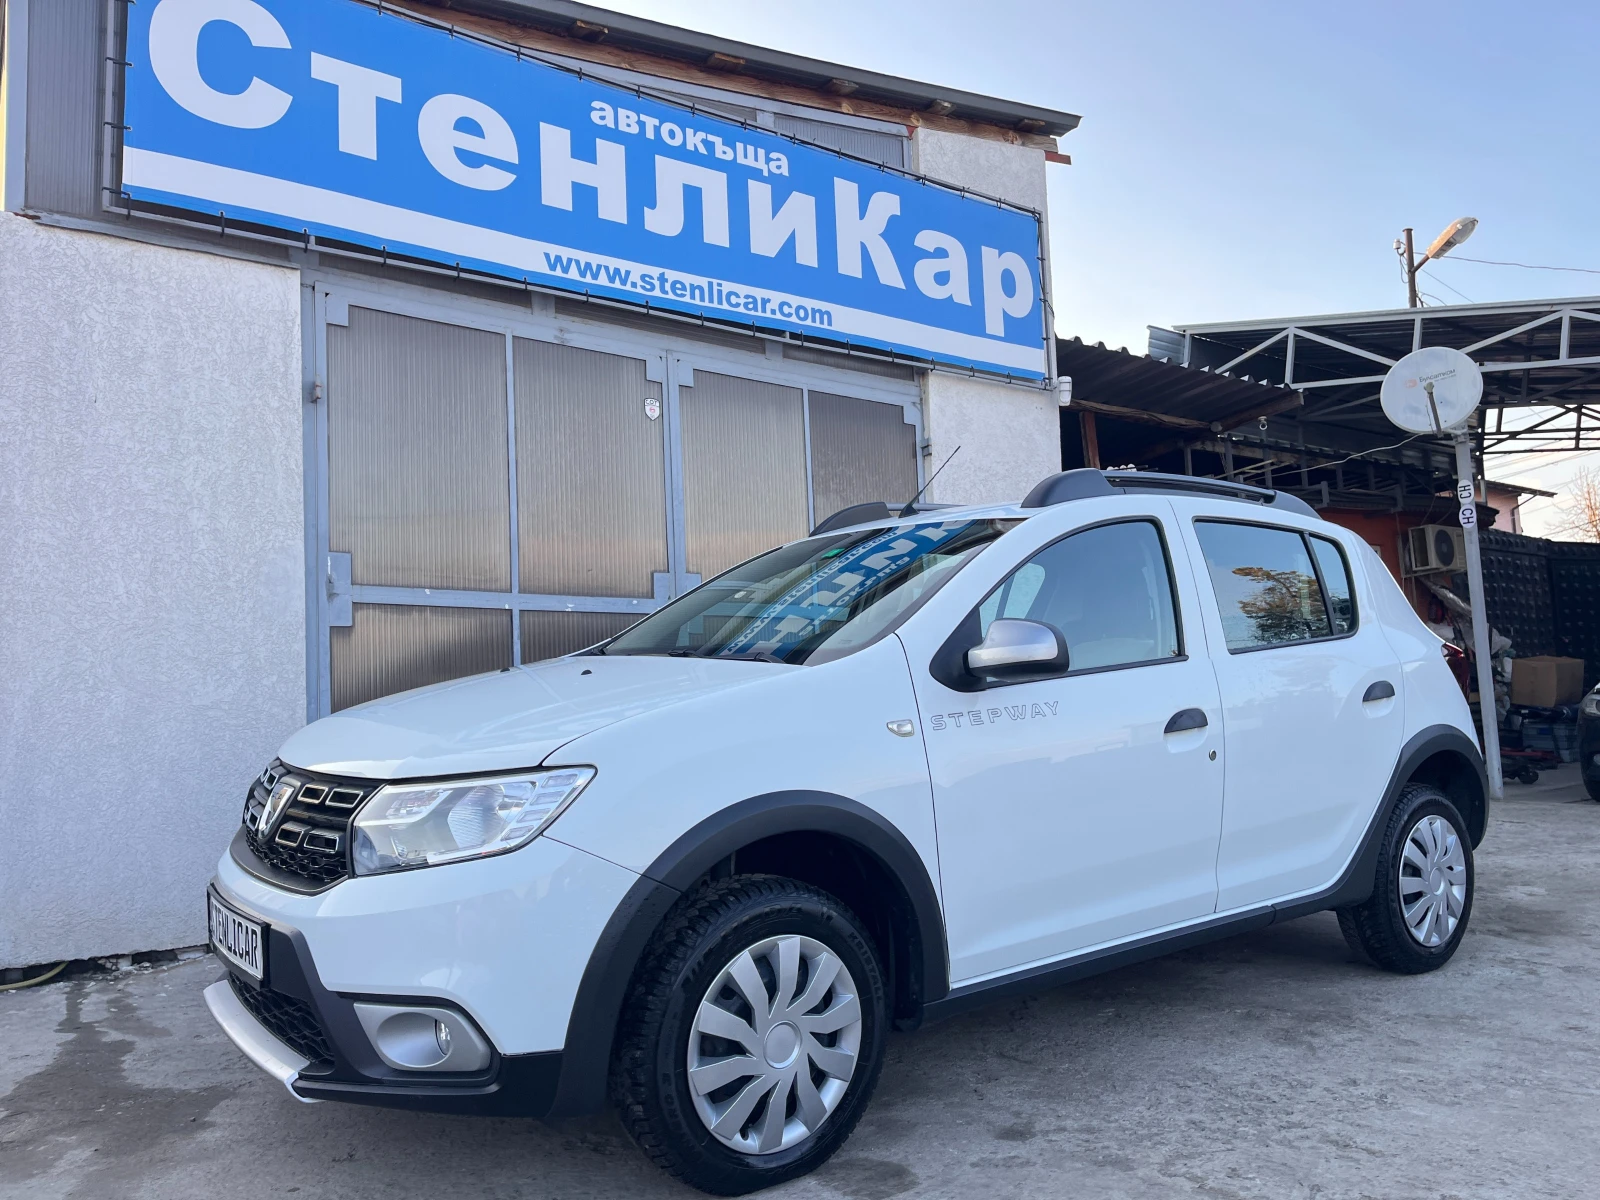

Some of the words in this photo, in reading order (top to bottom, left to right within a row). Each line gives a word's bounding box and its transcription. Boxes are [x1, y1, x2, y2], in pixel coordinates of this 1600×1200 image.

[149, 0, 1034, 337] СтенлиКар
[590, 100, 789, 177] автокъща
[543, 251, 833, 328] www.stenlicar.com
[1462, 508, 1475, 525] CH
[930, 701, 1059, 731] STEPWAY
